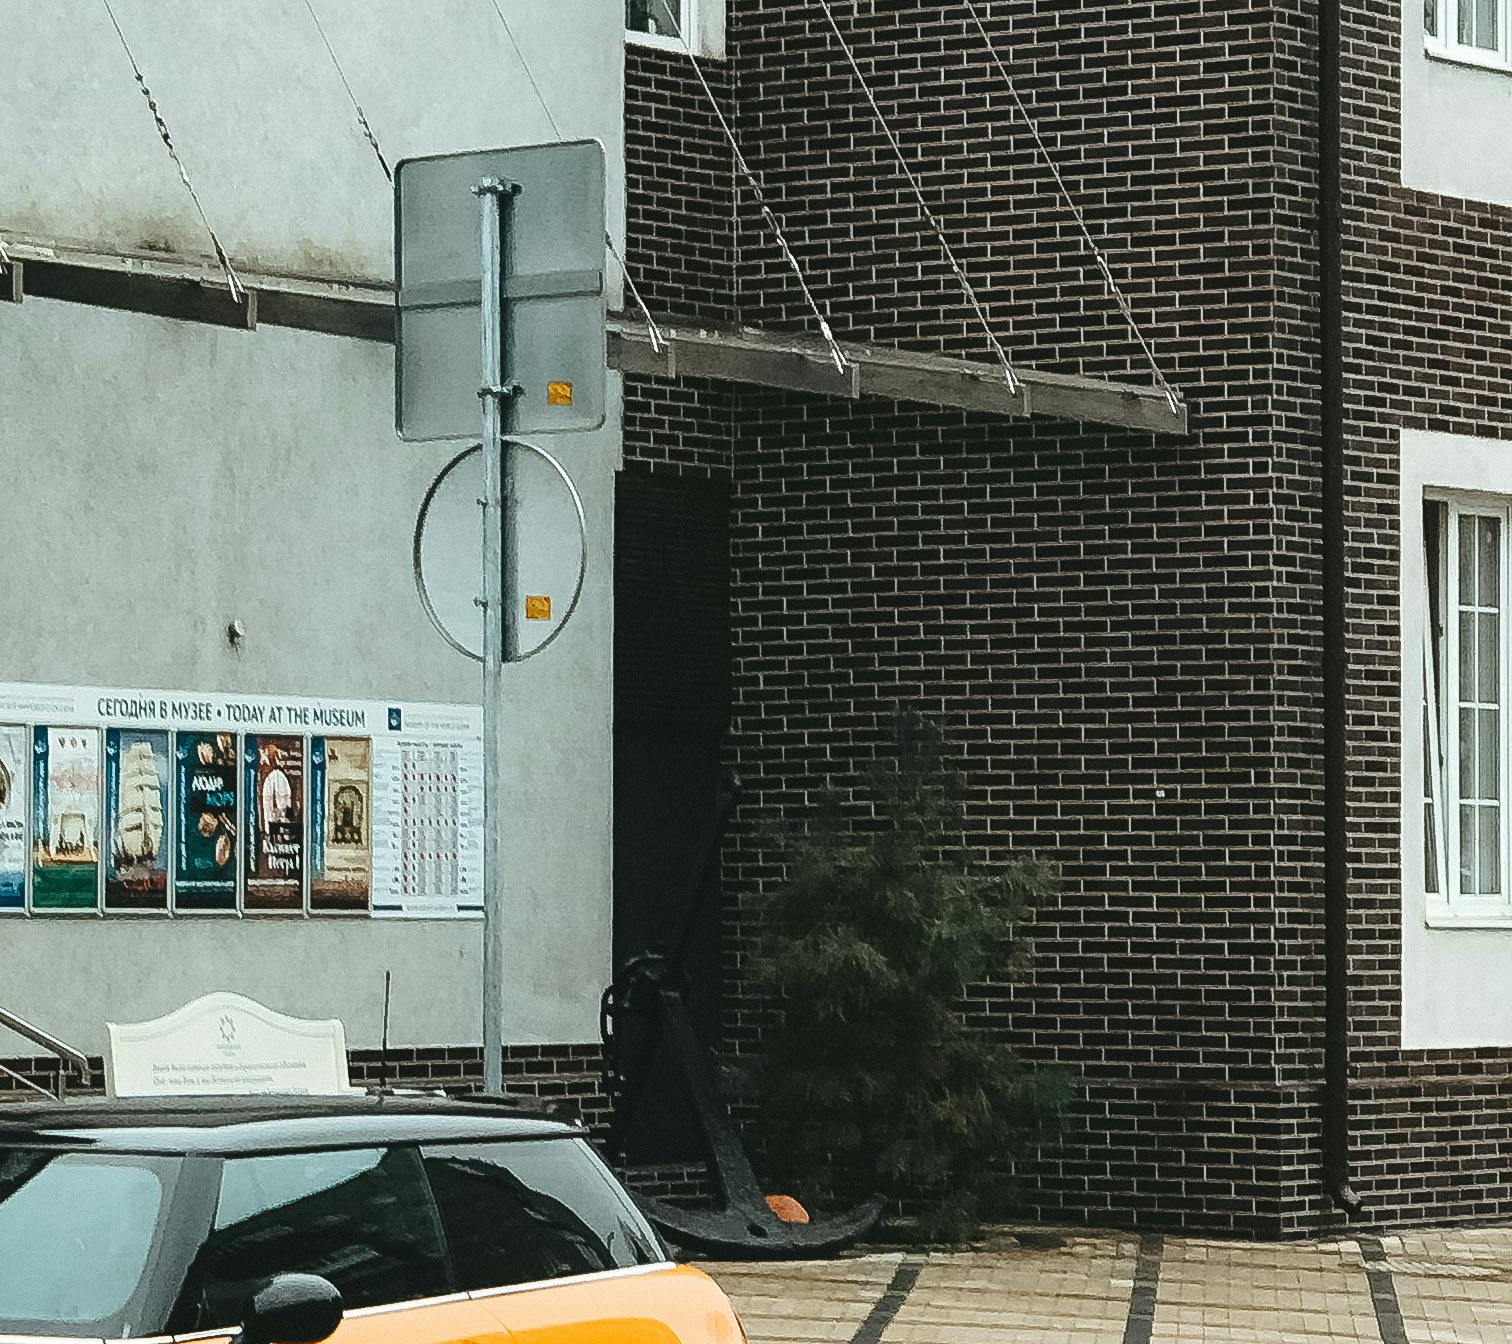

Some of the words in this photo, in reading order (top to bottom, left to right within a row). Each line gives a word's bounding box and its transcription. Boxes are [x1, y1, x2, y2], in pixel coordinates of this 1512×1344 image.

[97, 696, 156, 720] СЕГОДНЯ
[159, 700, 168, 719] В
[171, 700, 212, 722] МУЗЕЕ
[225, 704, 265, 724] TODAY
[268, 706, 283, 725] AT
[286, 706, 310, 726] THE
[313, 707, 366, 728] MUSEUM
